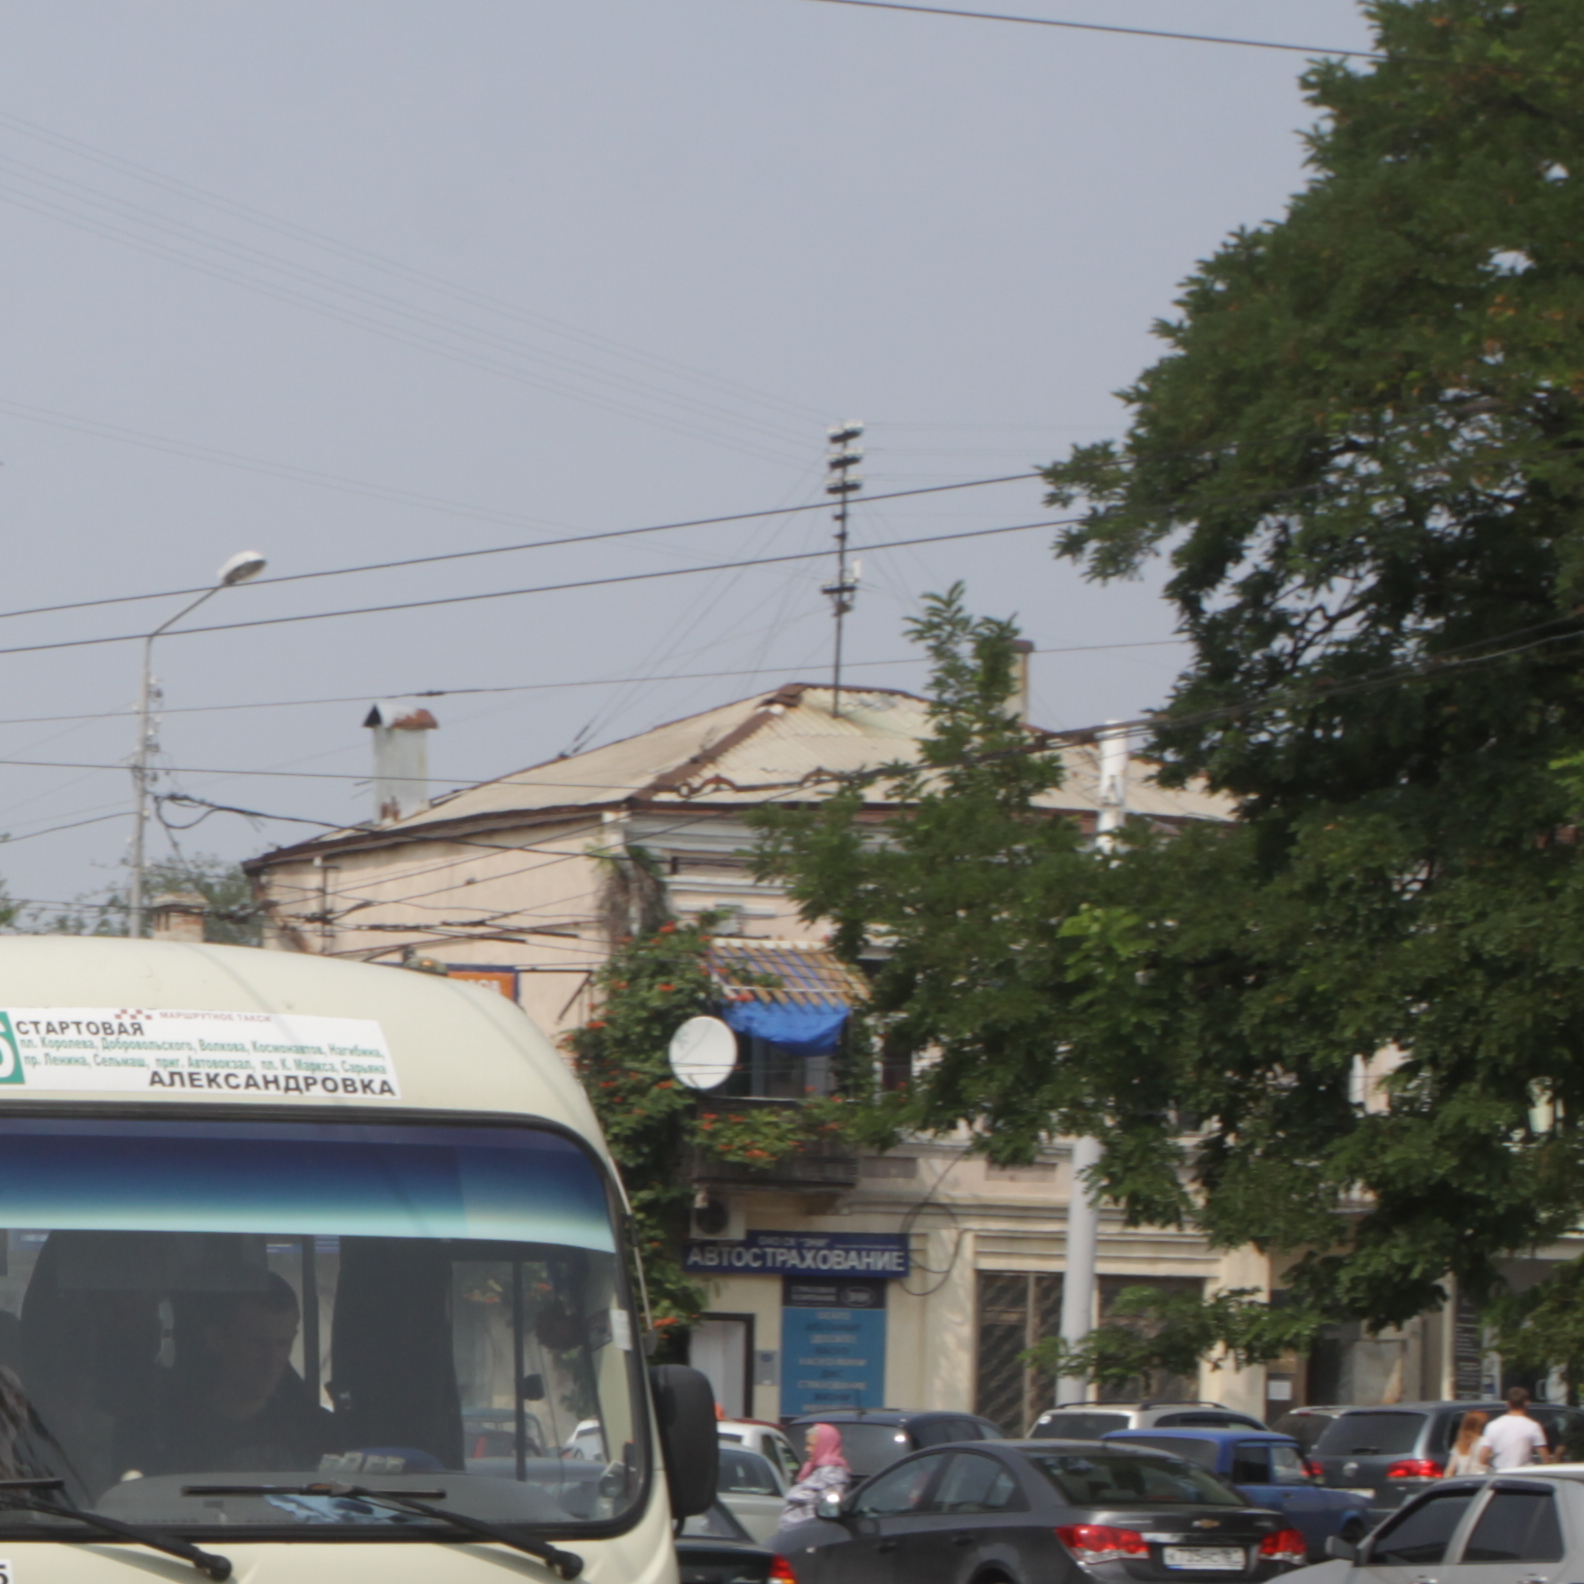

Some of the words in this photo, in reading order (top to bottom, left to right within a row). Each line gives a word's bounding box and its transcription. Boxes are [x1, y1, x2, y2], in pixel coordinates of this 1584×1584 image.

[15, 1020, 145, 1036] СТАРТОВАЯ
[40, 1037, 99, 1051] Королева,
[101, 1037, 197, 1053] Добровольского,
[198, 1039, 250, 1054] Волкова,
[251, 1041, 328, 1057] Космонавтов,
[44, 1053, 91, 1069] Ленина,
[148, 1070, 397, 1096] АЛЕКСАНДРОВКА
[686, 1247, 906, 1272] АВТОСТРАХОВАНИЕ
